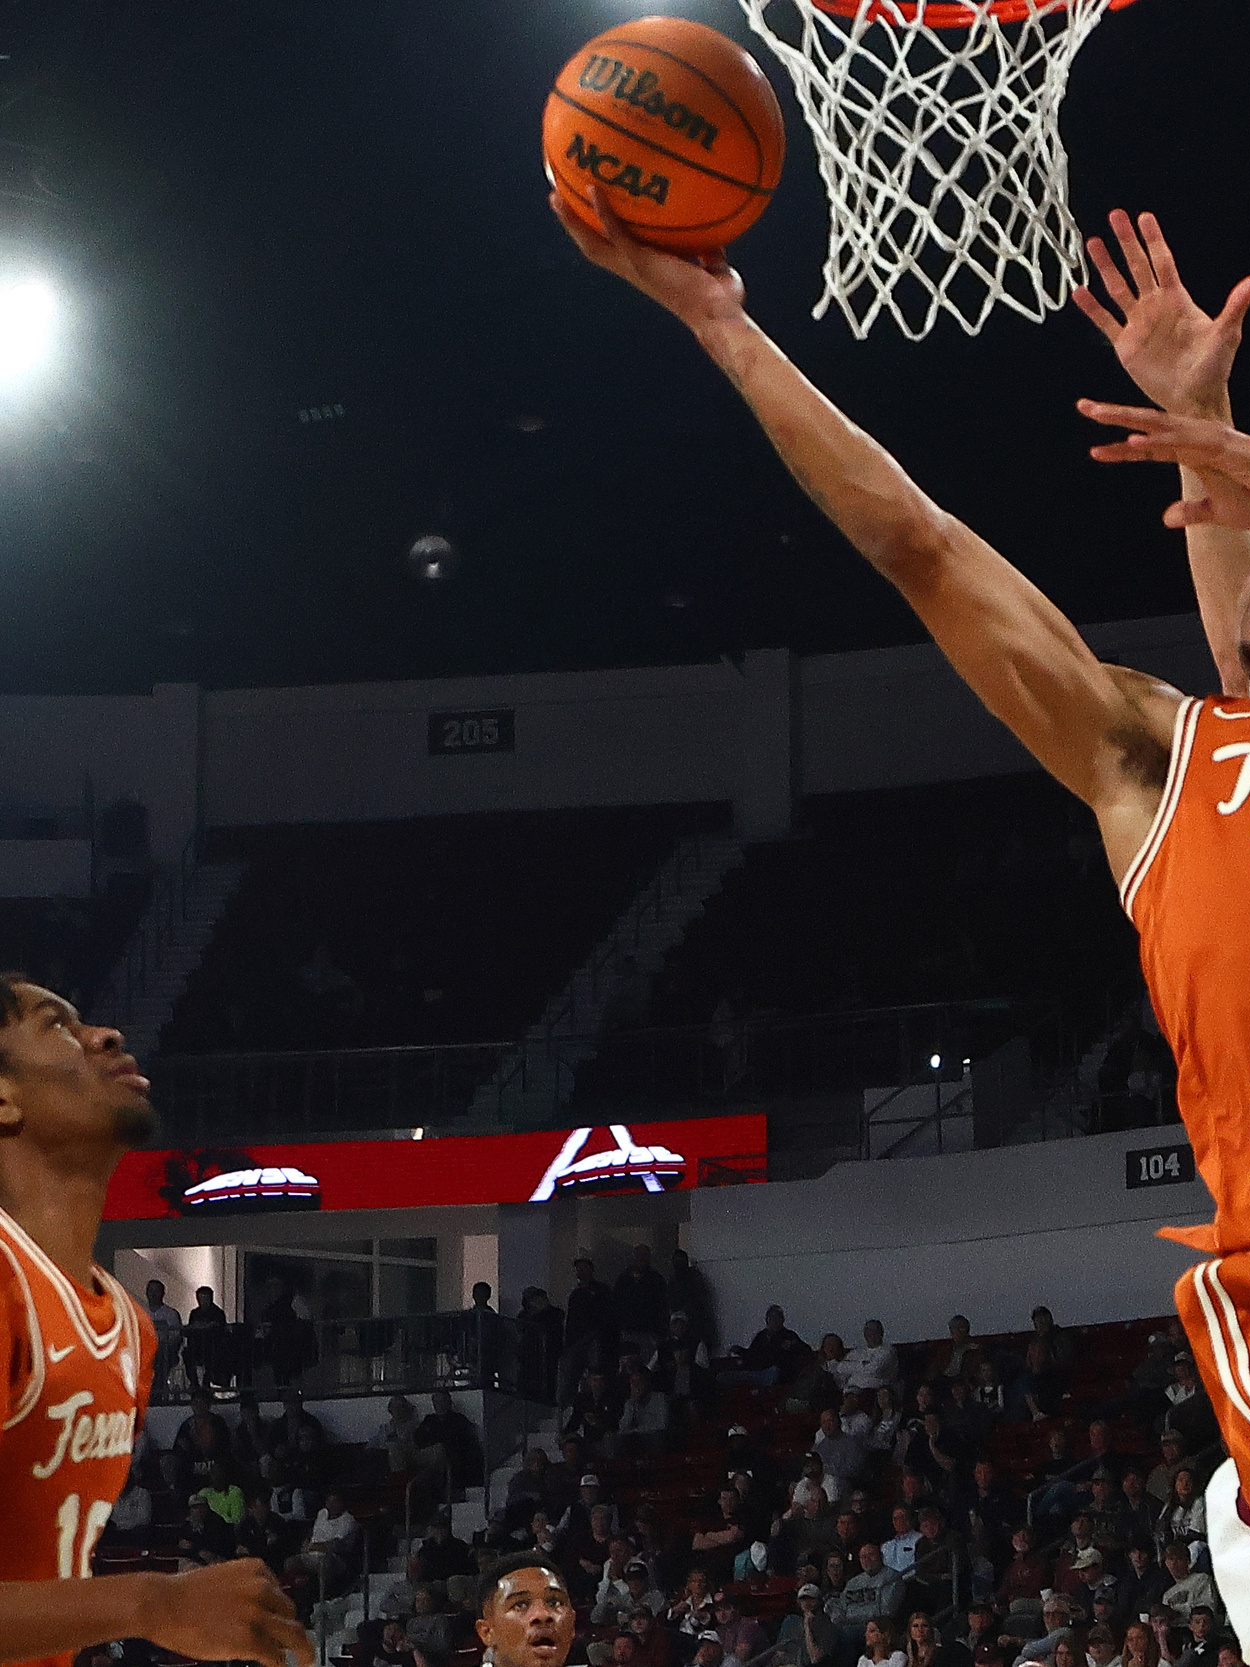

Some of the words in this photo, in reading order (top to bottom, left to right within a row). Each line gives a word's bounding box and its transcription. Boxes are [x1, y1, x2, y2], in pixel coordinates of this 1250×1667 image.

[578, 54, 719, 151] Wilson
[566, 134, 672, 206] NCAA
[443, 719, 500, 748] 205
[1139, 1152, 1181, 1181] 104
[32, 1391, 138, 1479] Texa
